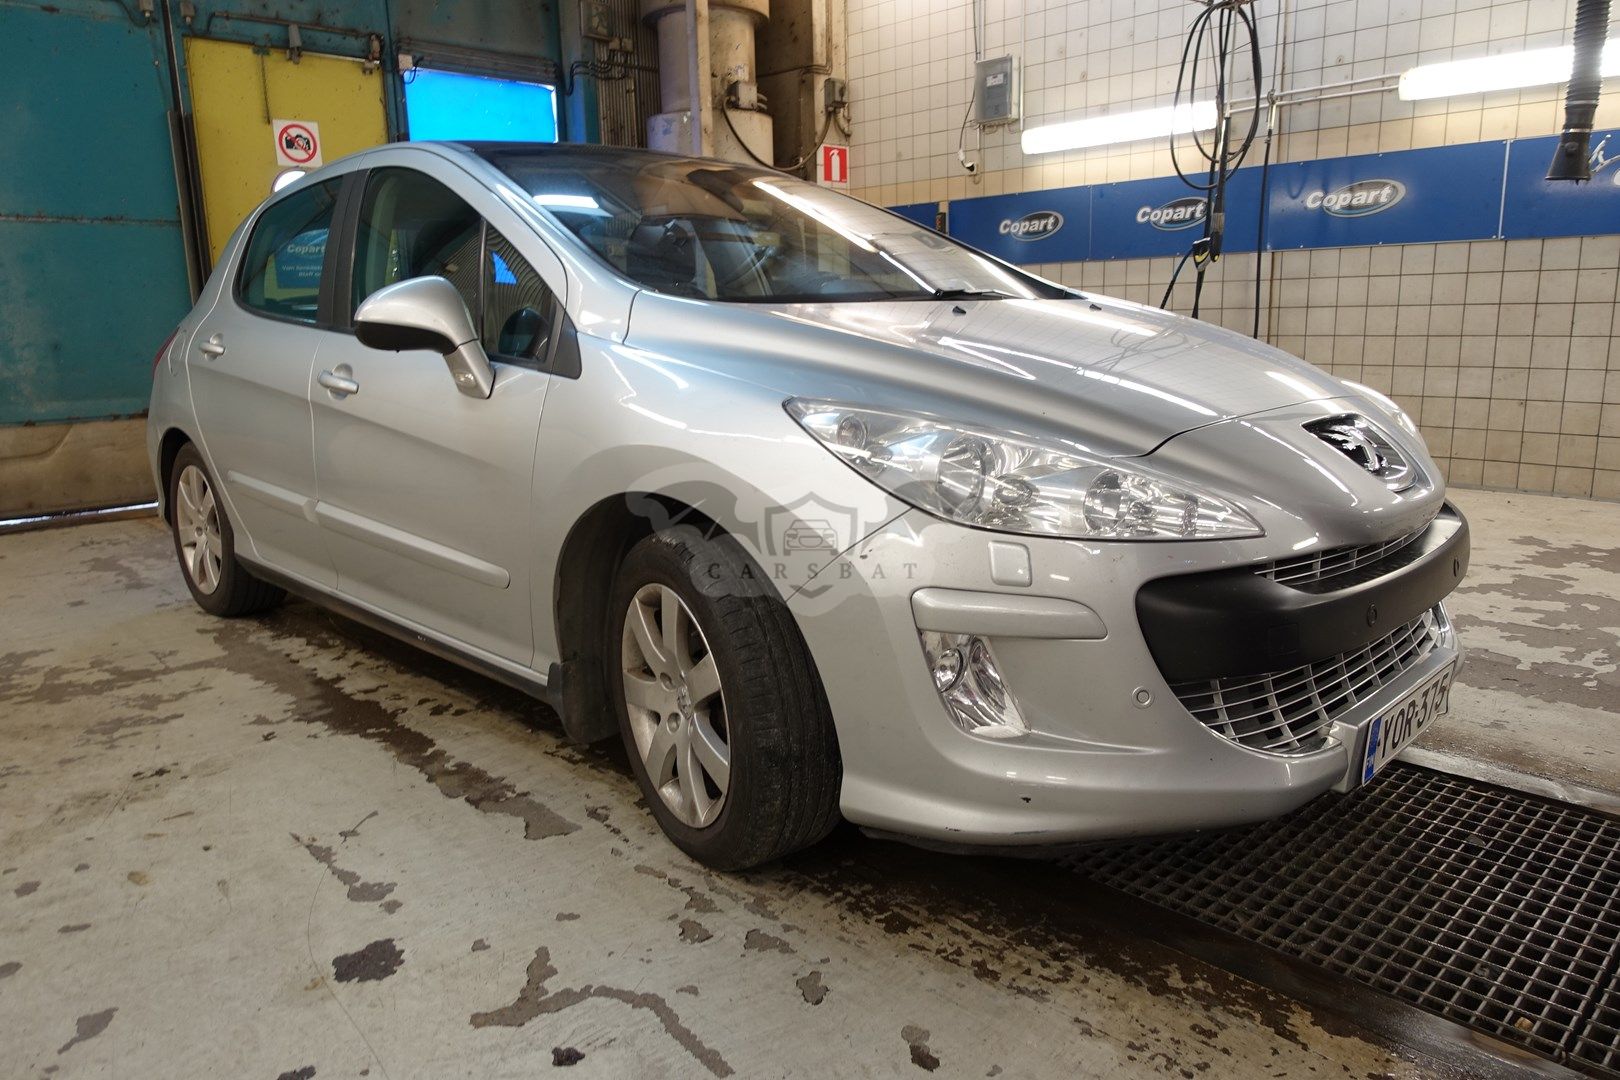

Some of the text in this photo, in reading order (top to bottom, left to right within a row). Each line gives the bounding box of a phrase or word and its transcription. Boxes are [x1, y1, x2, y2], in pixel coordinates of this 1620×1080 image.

[1306, 184, 1391, 211] Copart
[999, 215, 1055, 235] Copart
[1136, 202, 1204, 224] Copart
[1381, 672, 1449, 759] YOR-375
